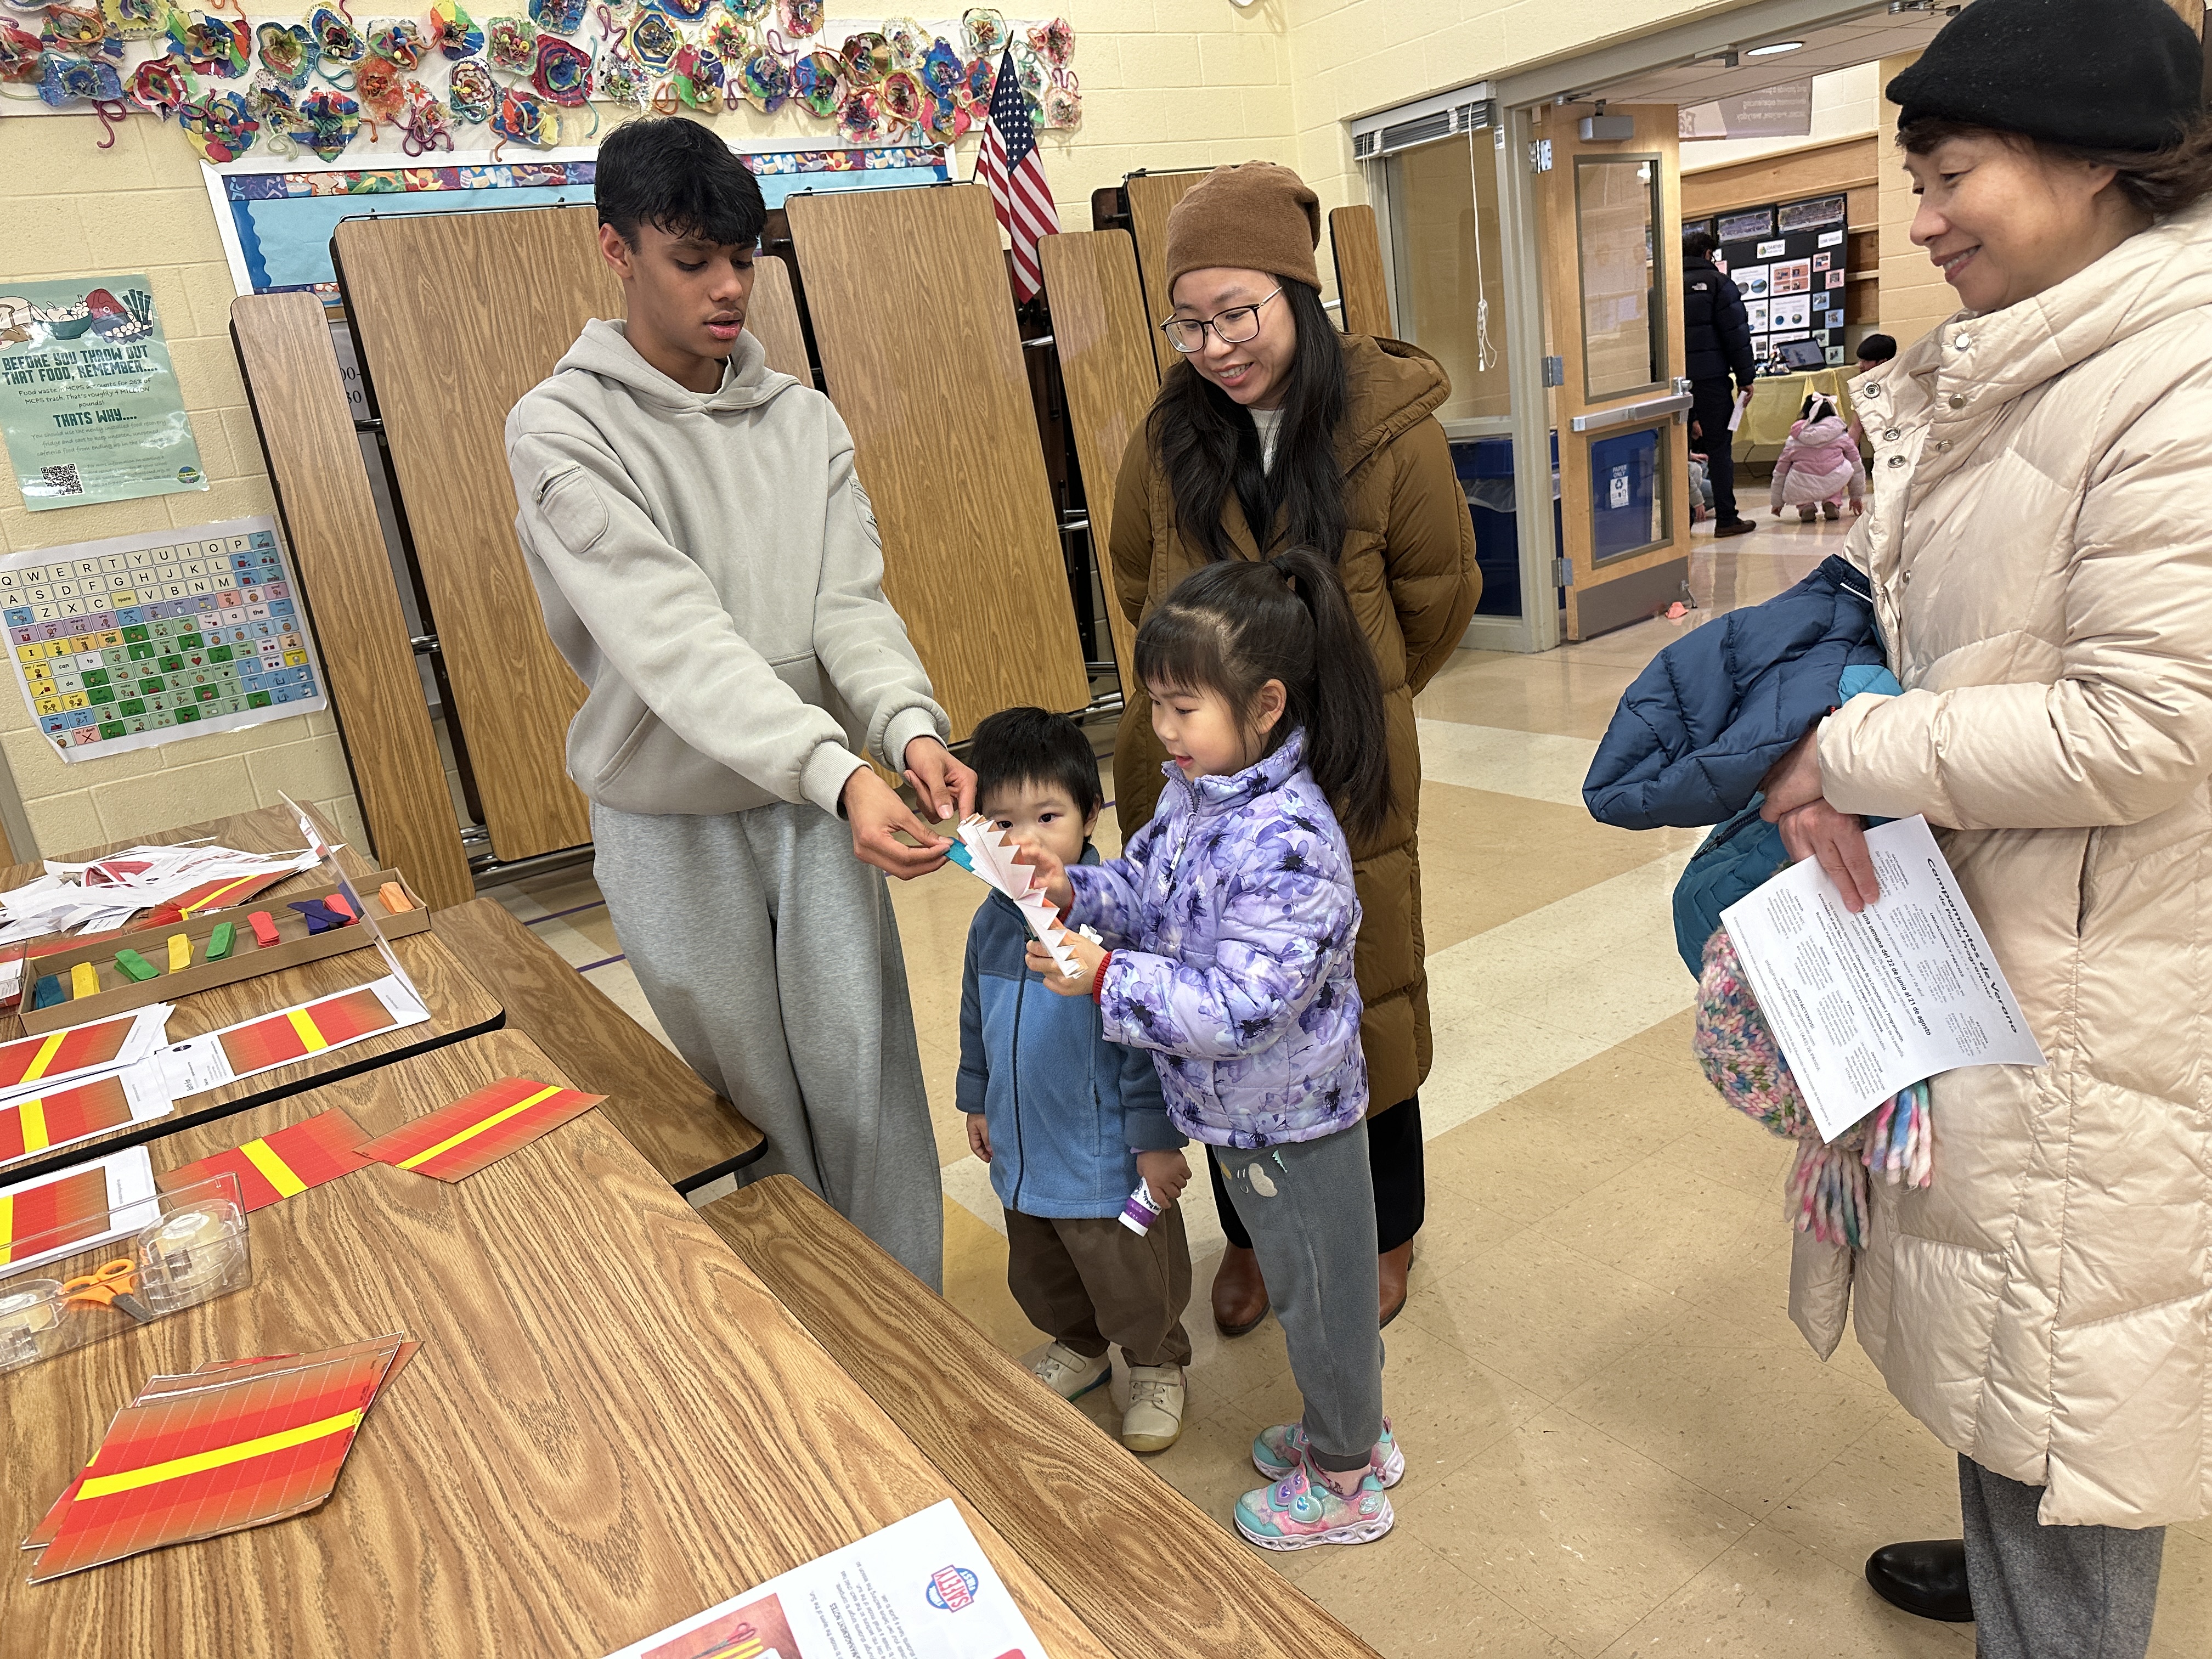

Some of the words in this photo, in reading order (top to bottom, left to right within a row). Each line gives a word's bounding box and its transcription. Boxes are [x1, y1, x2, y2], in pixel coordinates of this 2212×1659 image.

[1, 353, 51, 371] BEFORE
[52, 351, 77, 366] YOU
[79, 347, 123, 363] THROW
[125, 344, 148, 359] OUT
[2, 369, 34, 385] THAT
[37, 366, 75, 382] FOOD,
[78, 399, 105, 409] pounds!
[85, 381, 116, 390] accounts
[87, 390, 113, 398] roughly
[119, 385, 150, 394] MILLION
[52, 411, 93, 428] THATS
[1, 576, 12, 586] Q
[26, 571, 39, 582] W
[55, 567, 65, 577] E
[82, 563, 92, 573] R
[108, 558, 116, 568] T
[133, 555, 142, 564] Y
[159, 551, 168, 560] U
[187, 548, 191, 556] I
[208, 543, 218, 552] O
[234, 540, 241, 549] P
[9, 594, 18, 604] A
[35, 590, 44, 599] S
[61, 585, 71, 595] D
[88, 581, 95, 590] F
[114, 577, 123, 586] G
[139, 572, 149, 582] H
[166, 568, 173, 578] J
[189, 564, 199, 574] K
[215, 561, 223, 569] L
[41, 607, 51, 617] Z
[66, 603, 77, 613] X
[94, 599, 104, 608] C
[144, 590, 153, 599] V
[170, 586, 179, 595] B
[194, 582, 204, 591] N
[218, 577, 229, 588] M
[1927, 858, 1979, 958] Campamentos
[1979, 962, 1990, 979] de
[1990, 981, 2017, 1033] Verano
[1929, 912, 1950, 949] UBICACIONES
[1950, 953, 1964, 977] PRECIOS
[1938, 895, 1945, 906] de
[1945, 908, 1962, 938] Panda
[1960, 940, 1993, 1000] Programmer
[1861, 913, 1871, 925] una
[1868, 925, 1883, 949] semana
[1881, 949, 1891, 958] del
[1886, 958, 1895, 967] 22
[1894, 975, 1906, 991] junio
[1908, 997, 1916, 1006] 21
[1917, 1015, 1931, 1035] agosto
[1764, 959, 1801, 1030] info@PandaProgrammer.com
[1799, 1032, 1809, 1046] (443)
[1809, 1053, 1820, 1071] PANDA
[1780, 977, 1815, 1046] www.PandaProgrammer.com
[934, 1569, 969, 1609] SAFETY
[960, 1570, 977, 1590] FIRST
[829, 1602, 843, 1621] NOTES
